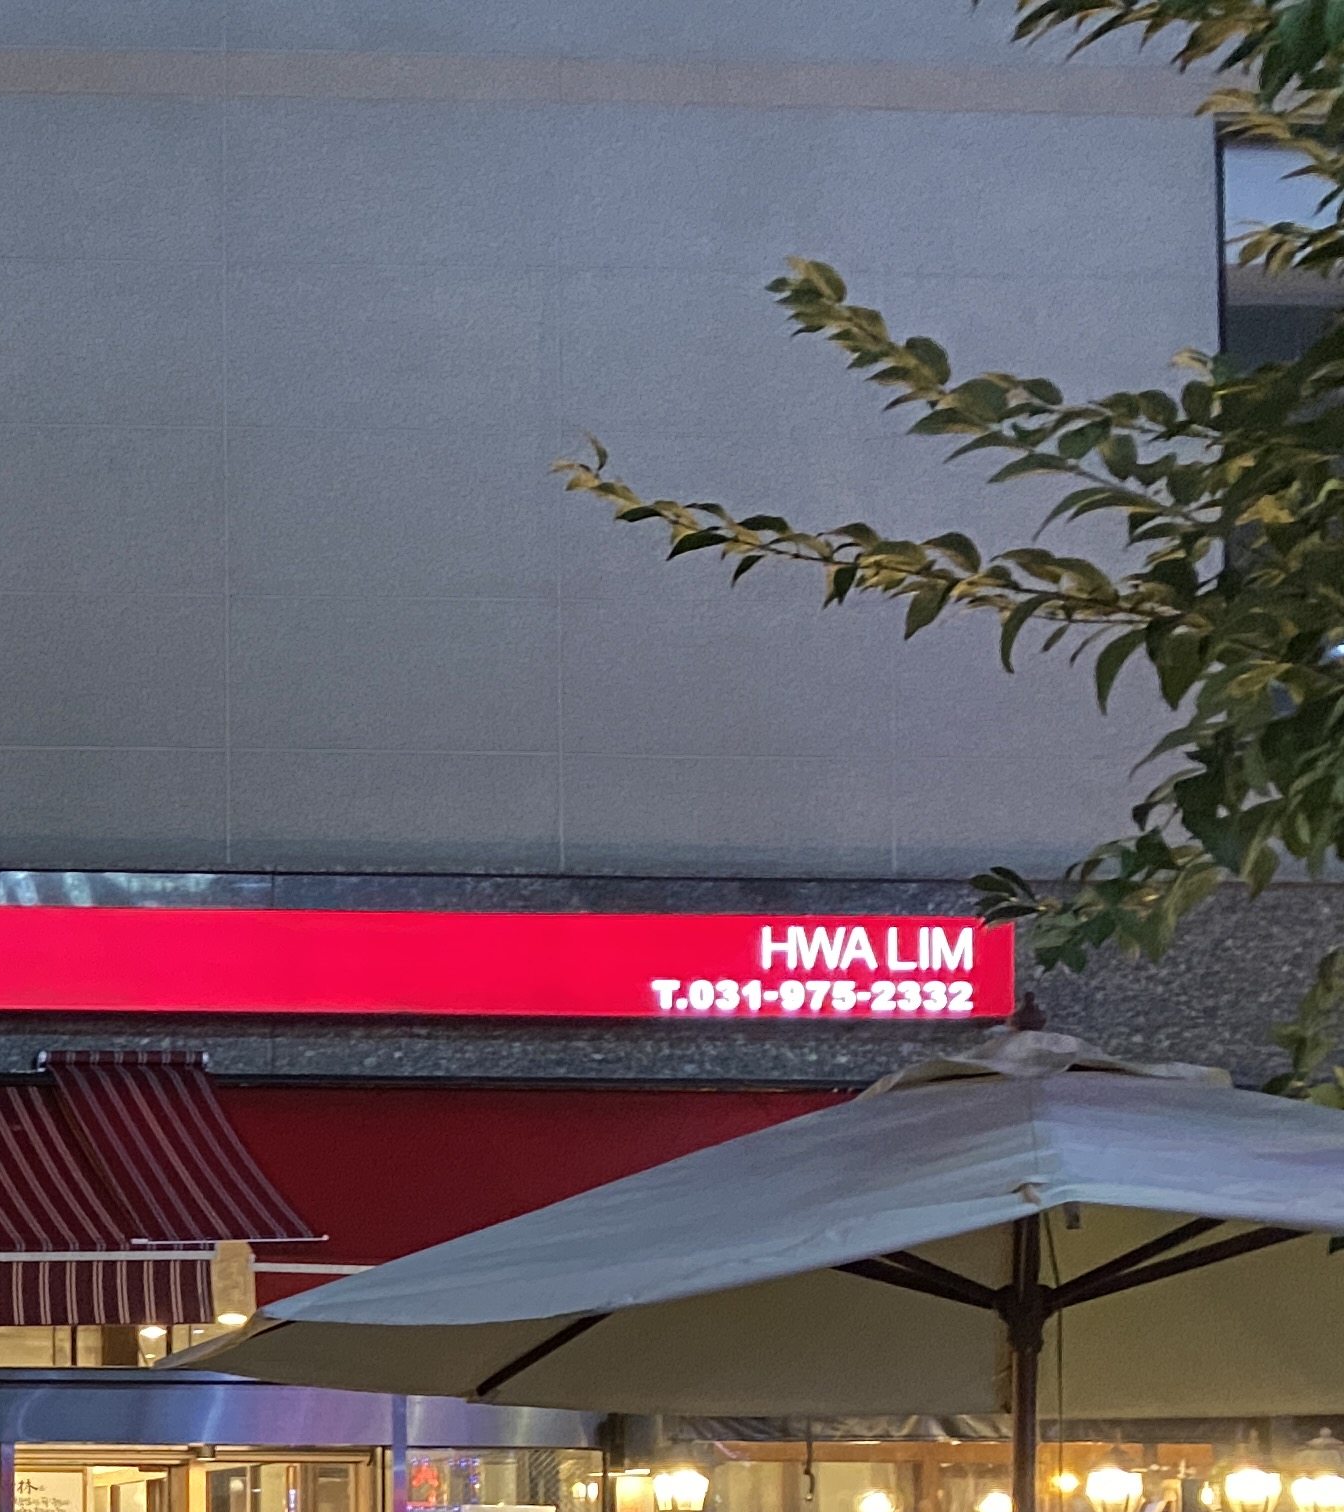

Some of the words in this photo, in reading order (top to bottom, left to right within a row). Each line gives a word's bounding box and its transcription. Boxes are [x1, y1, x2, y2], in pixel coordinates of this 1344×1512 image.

[760, 924, 878, 971] HWA
[886, 926, 974, 971] LIM
[651, 978, 974, 1012] T.031-975-2332
